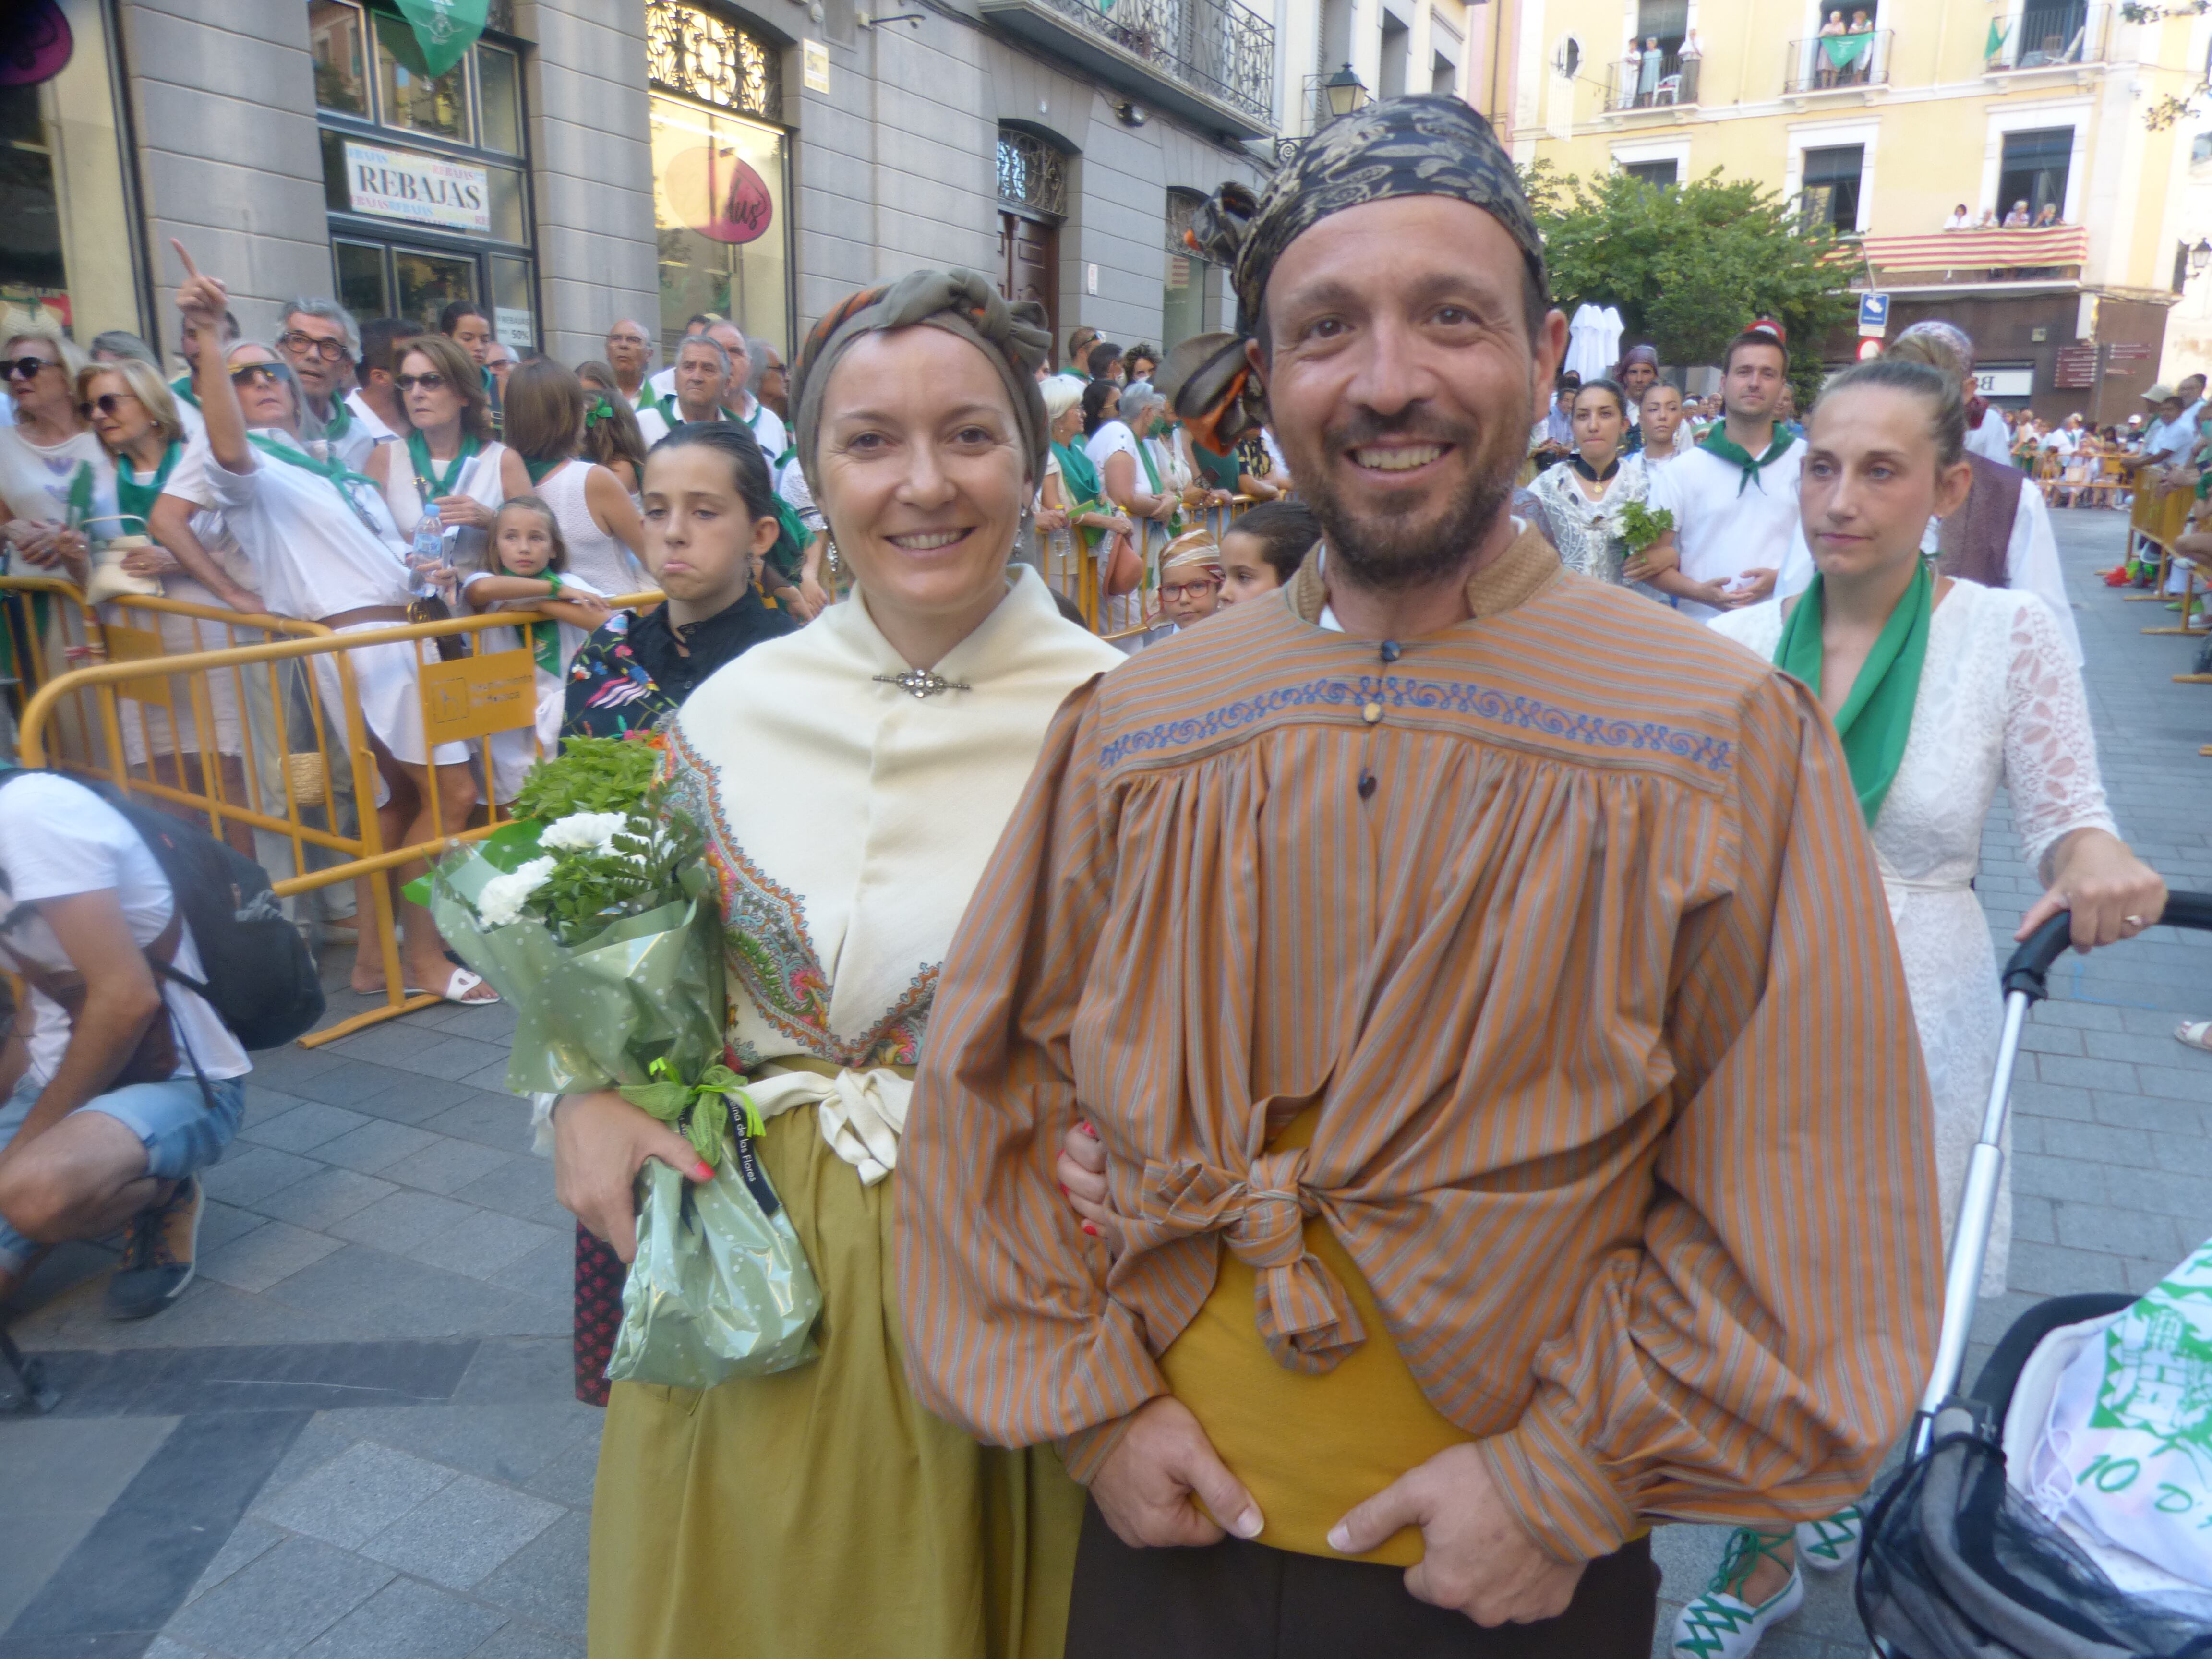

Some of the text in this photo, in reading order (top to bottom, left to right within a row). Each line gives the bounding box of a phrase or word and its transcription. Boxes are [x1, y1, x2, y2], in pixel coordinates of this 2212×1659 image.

[359, 165, 481, 210] REBAJAS
[728, 1099, 757, 1182] eina de las Flores
[2076, 1454, 2141, 1494] 10
